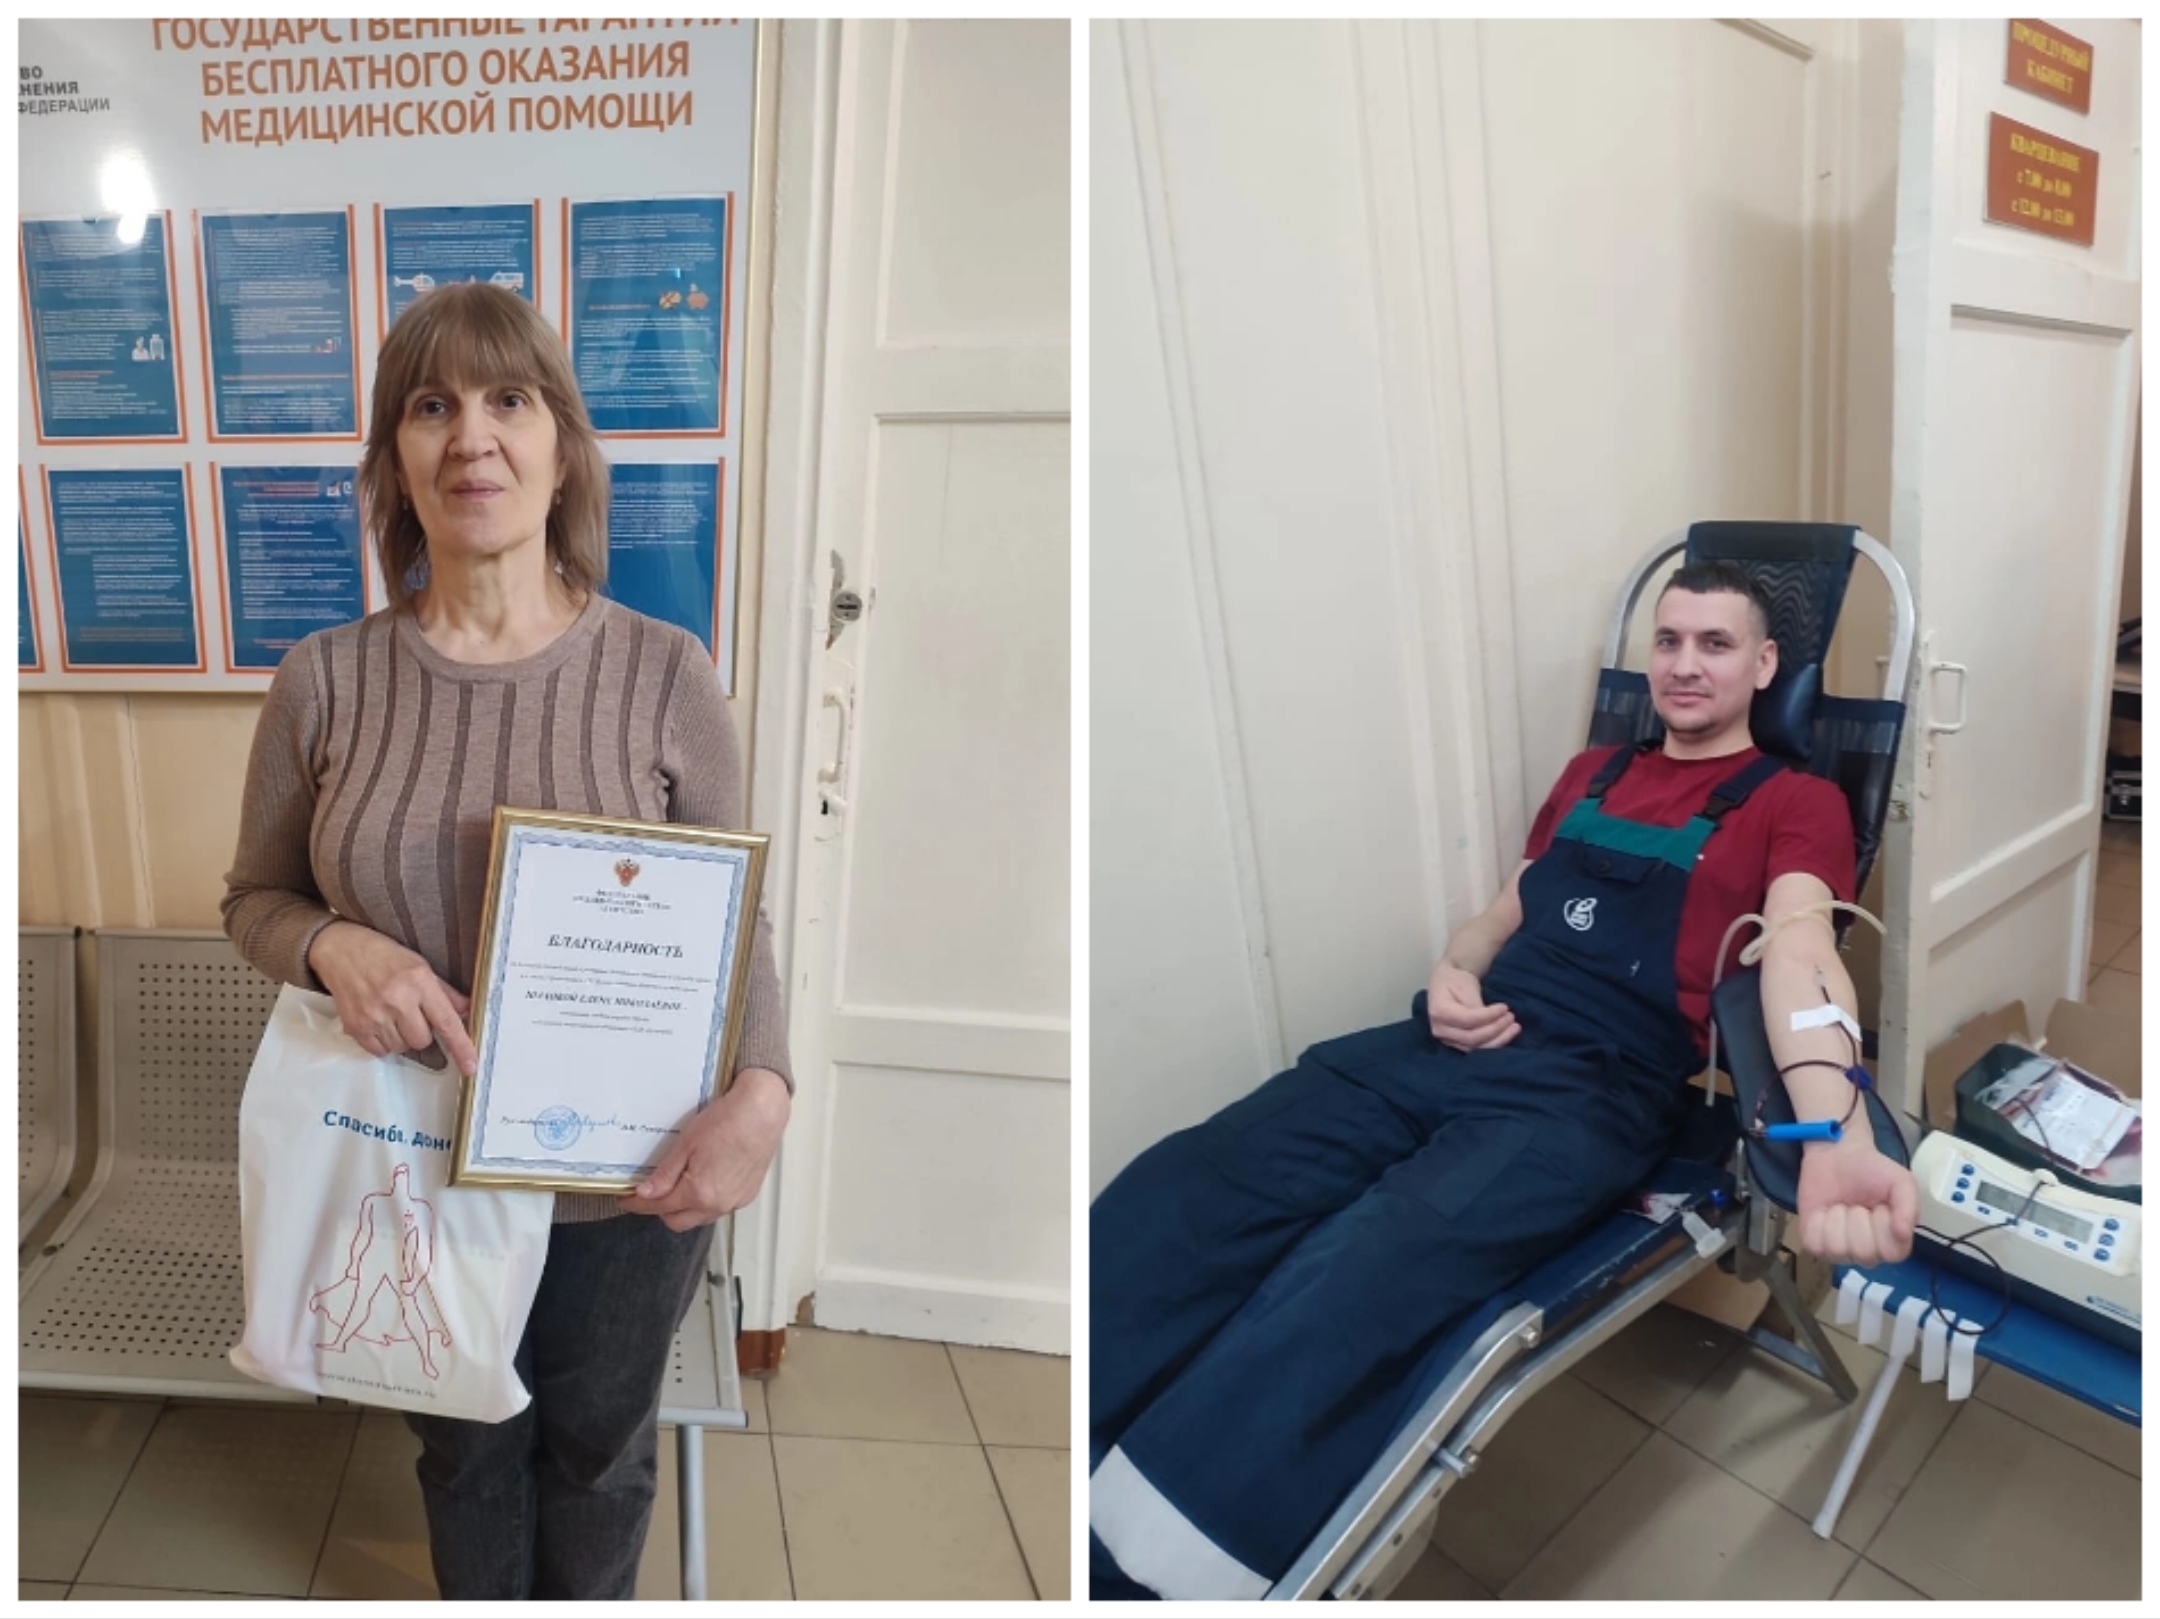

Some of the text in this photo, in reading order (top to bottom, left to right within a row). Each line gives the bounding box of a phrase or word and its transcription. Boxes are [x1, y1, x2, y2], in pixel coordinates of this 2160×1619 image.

[201, 40, 690, 96] БЕСПЛАТНОГО ОКАЗАНИЯ
[18, 81, 79, 96] НЕНИЯ
[18, 97, 111, 116] ФЕДЕРАЦИИ
[201, 90, 693, 147] МЕДИЦИНСКОЙ ПОМОЩИ
[547, 933, 684, 959] БЛАГОДАРНОСТЬ
